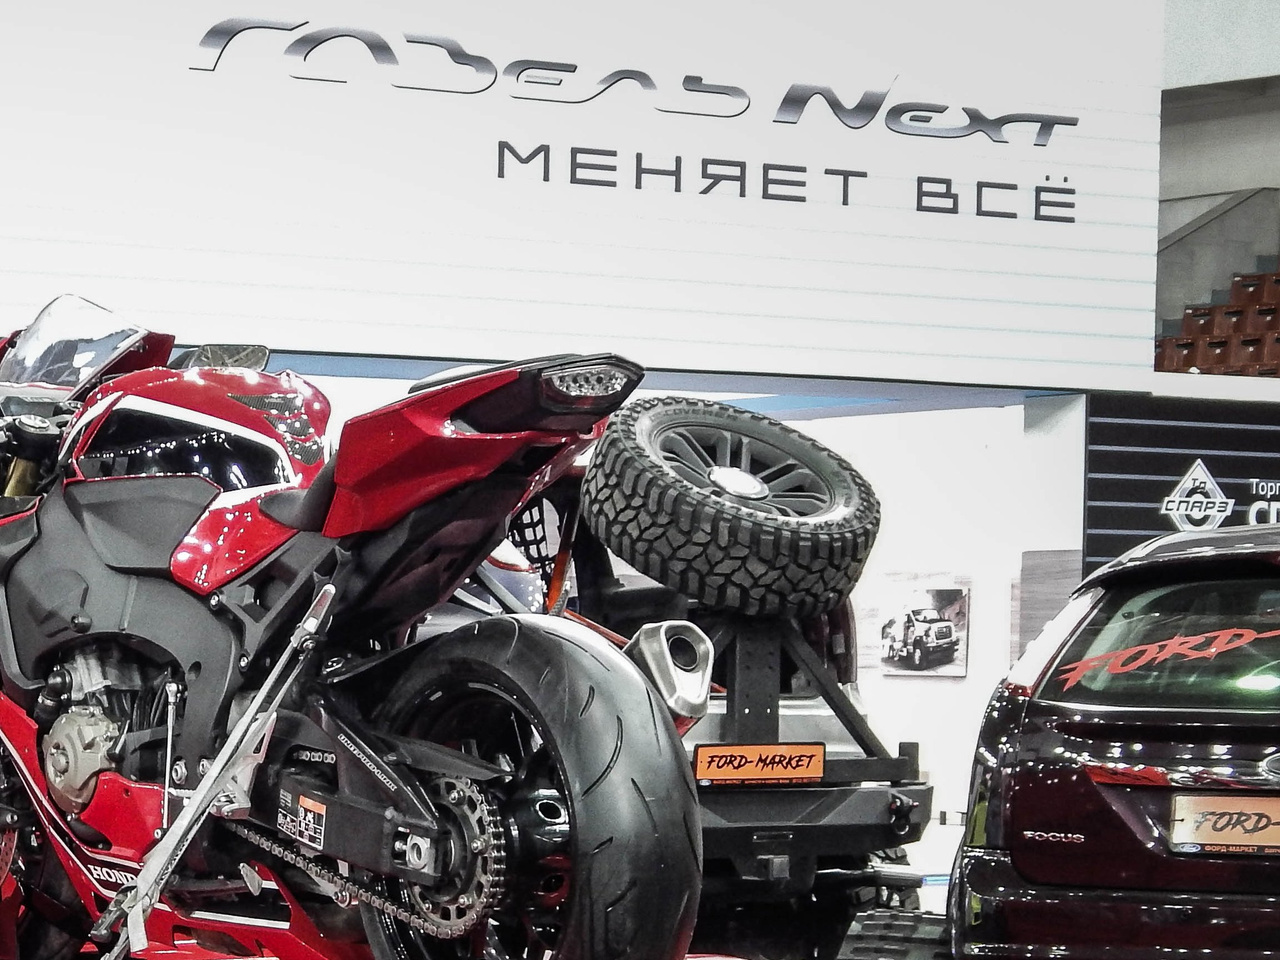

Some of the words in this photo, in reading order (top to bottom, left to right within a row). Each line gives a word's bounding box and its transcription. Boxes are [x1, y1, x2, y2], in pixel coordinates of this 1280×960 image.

[497, 140, 868, 206] МЕНЯЕТ
[916, 175, 1076, 224] ВСЁ
[1164, 500, 1229, 513] СПАРЗ
[707, 753, 816, 771] FORD-MARKET
[1023, 831, 1085, 843] FOCUS
[87, 864, 137, 885] HOND
